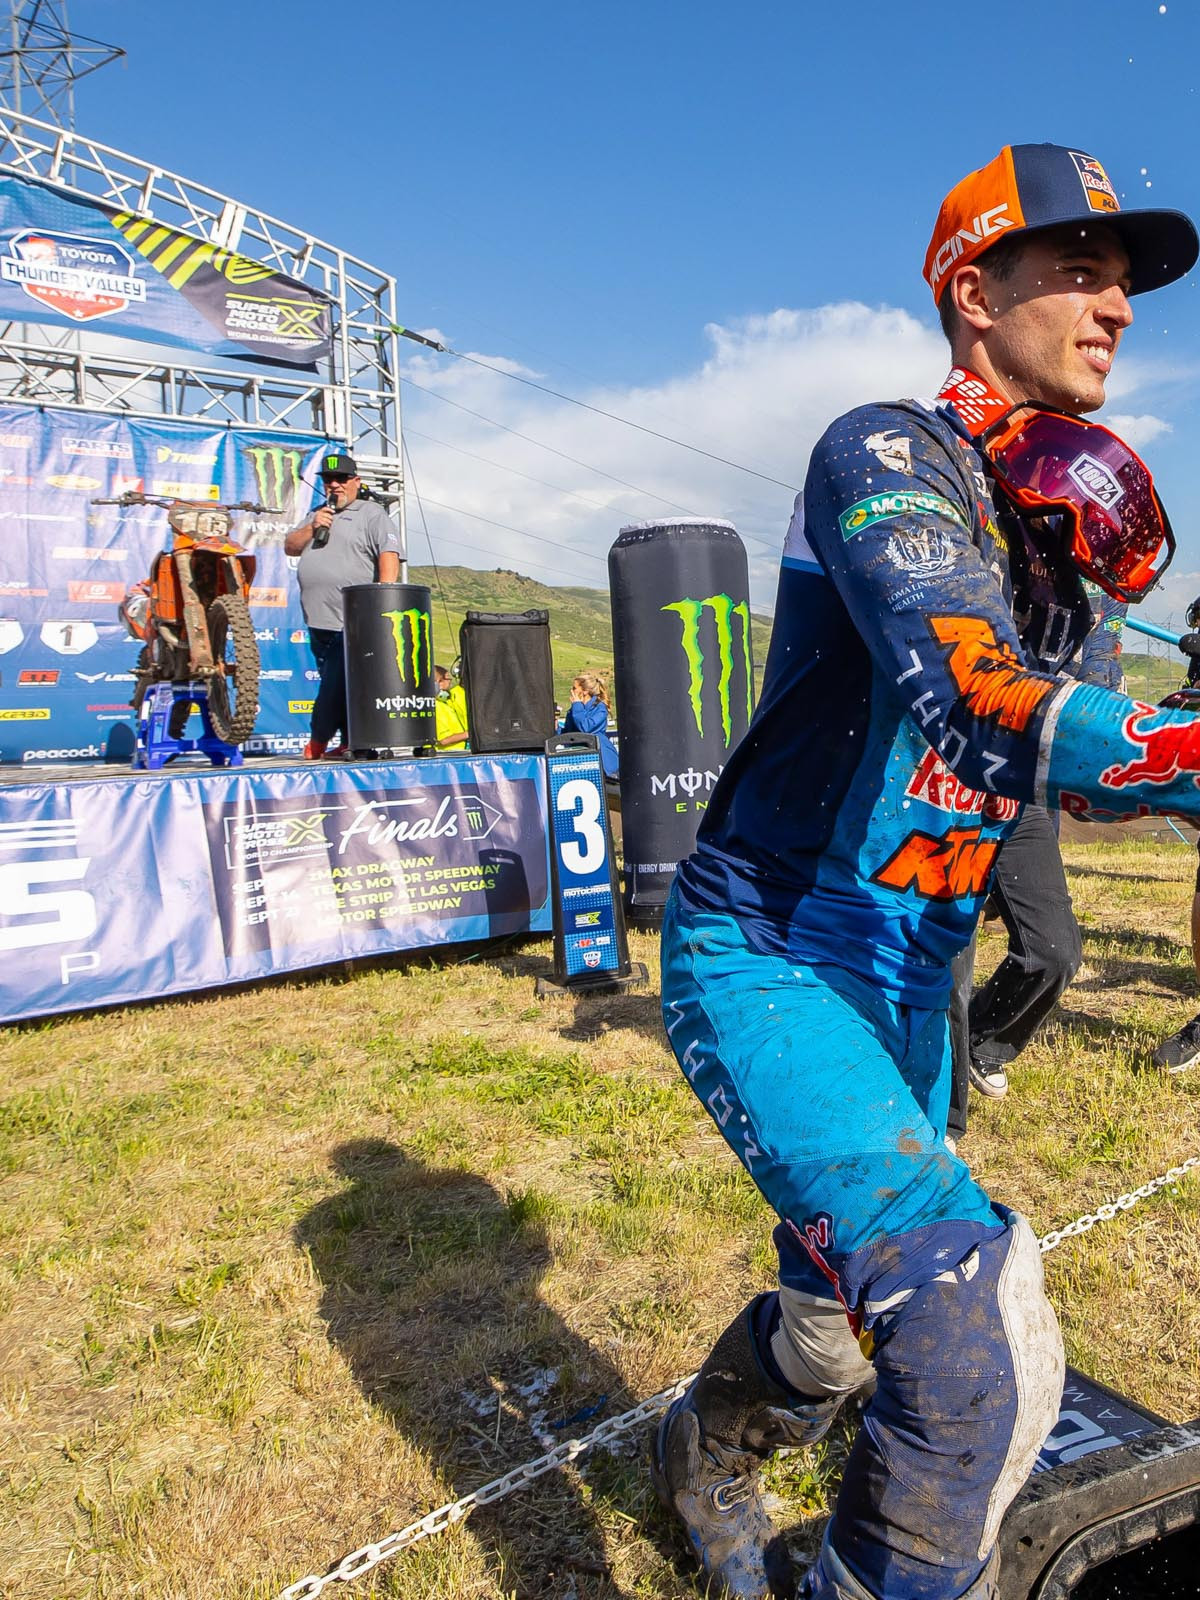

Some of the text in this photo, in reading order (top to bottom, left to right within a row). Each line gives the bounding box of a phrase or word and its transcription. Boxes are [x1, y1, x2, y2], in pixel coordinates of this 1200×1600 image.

[59, 246, 117, 265] TOYOTA
[84, 275, 141, 296] VALLEY
[225, 300, 280, 315] SUPER
[229, 309, 279, 323] MOTO
[65, 440, 130, 452] PARTS
[1077, 463, 1119, 500] 100%
[175, 511, 229, 537] 16
[887, 587, 912, 604] LOMA
[892, 592, 925, 614] HEALTH
[60, 624, 73, 646] 1
[389, 711, 436, 719] ENERG
[24, 745, 99, 761] peacock
[338, 796, 459, 855] Finals
[557, 779, 606, 875] 3
[357, 856, 435, 876] DRAGWAY
[638, 863, 658, 873] ENERGY
[659, 862, 678, 872] DRINK
[873, 825, 1001, 901] KTM
[366, 871, 421, 890] MOTOR
[426, 864, 501, 882] SPEEDWAY
[350, 891, 394, 908] STRIP
[420, 883, 449, 897] LAS
[450, 879, 496, 893] VEGAS
[379, 897, 462, 918] SPEEDWAY
[60, 951, 101, 985] P
